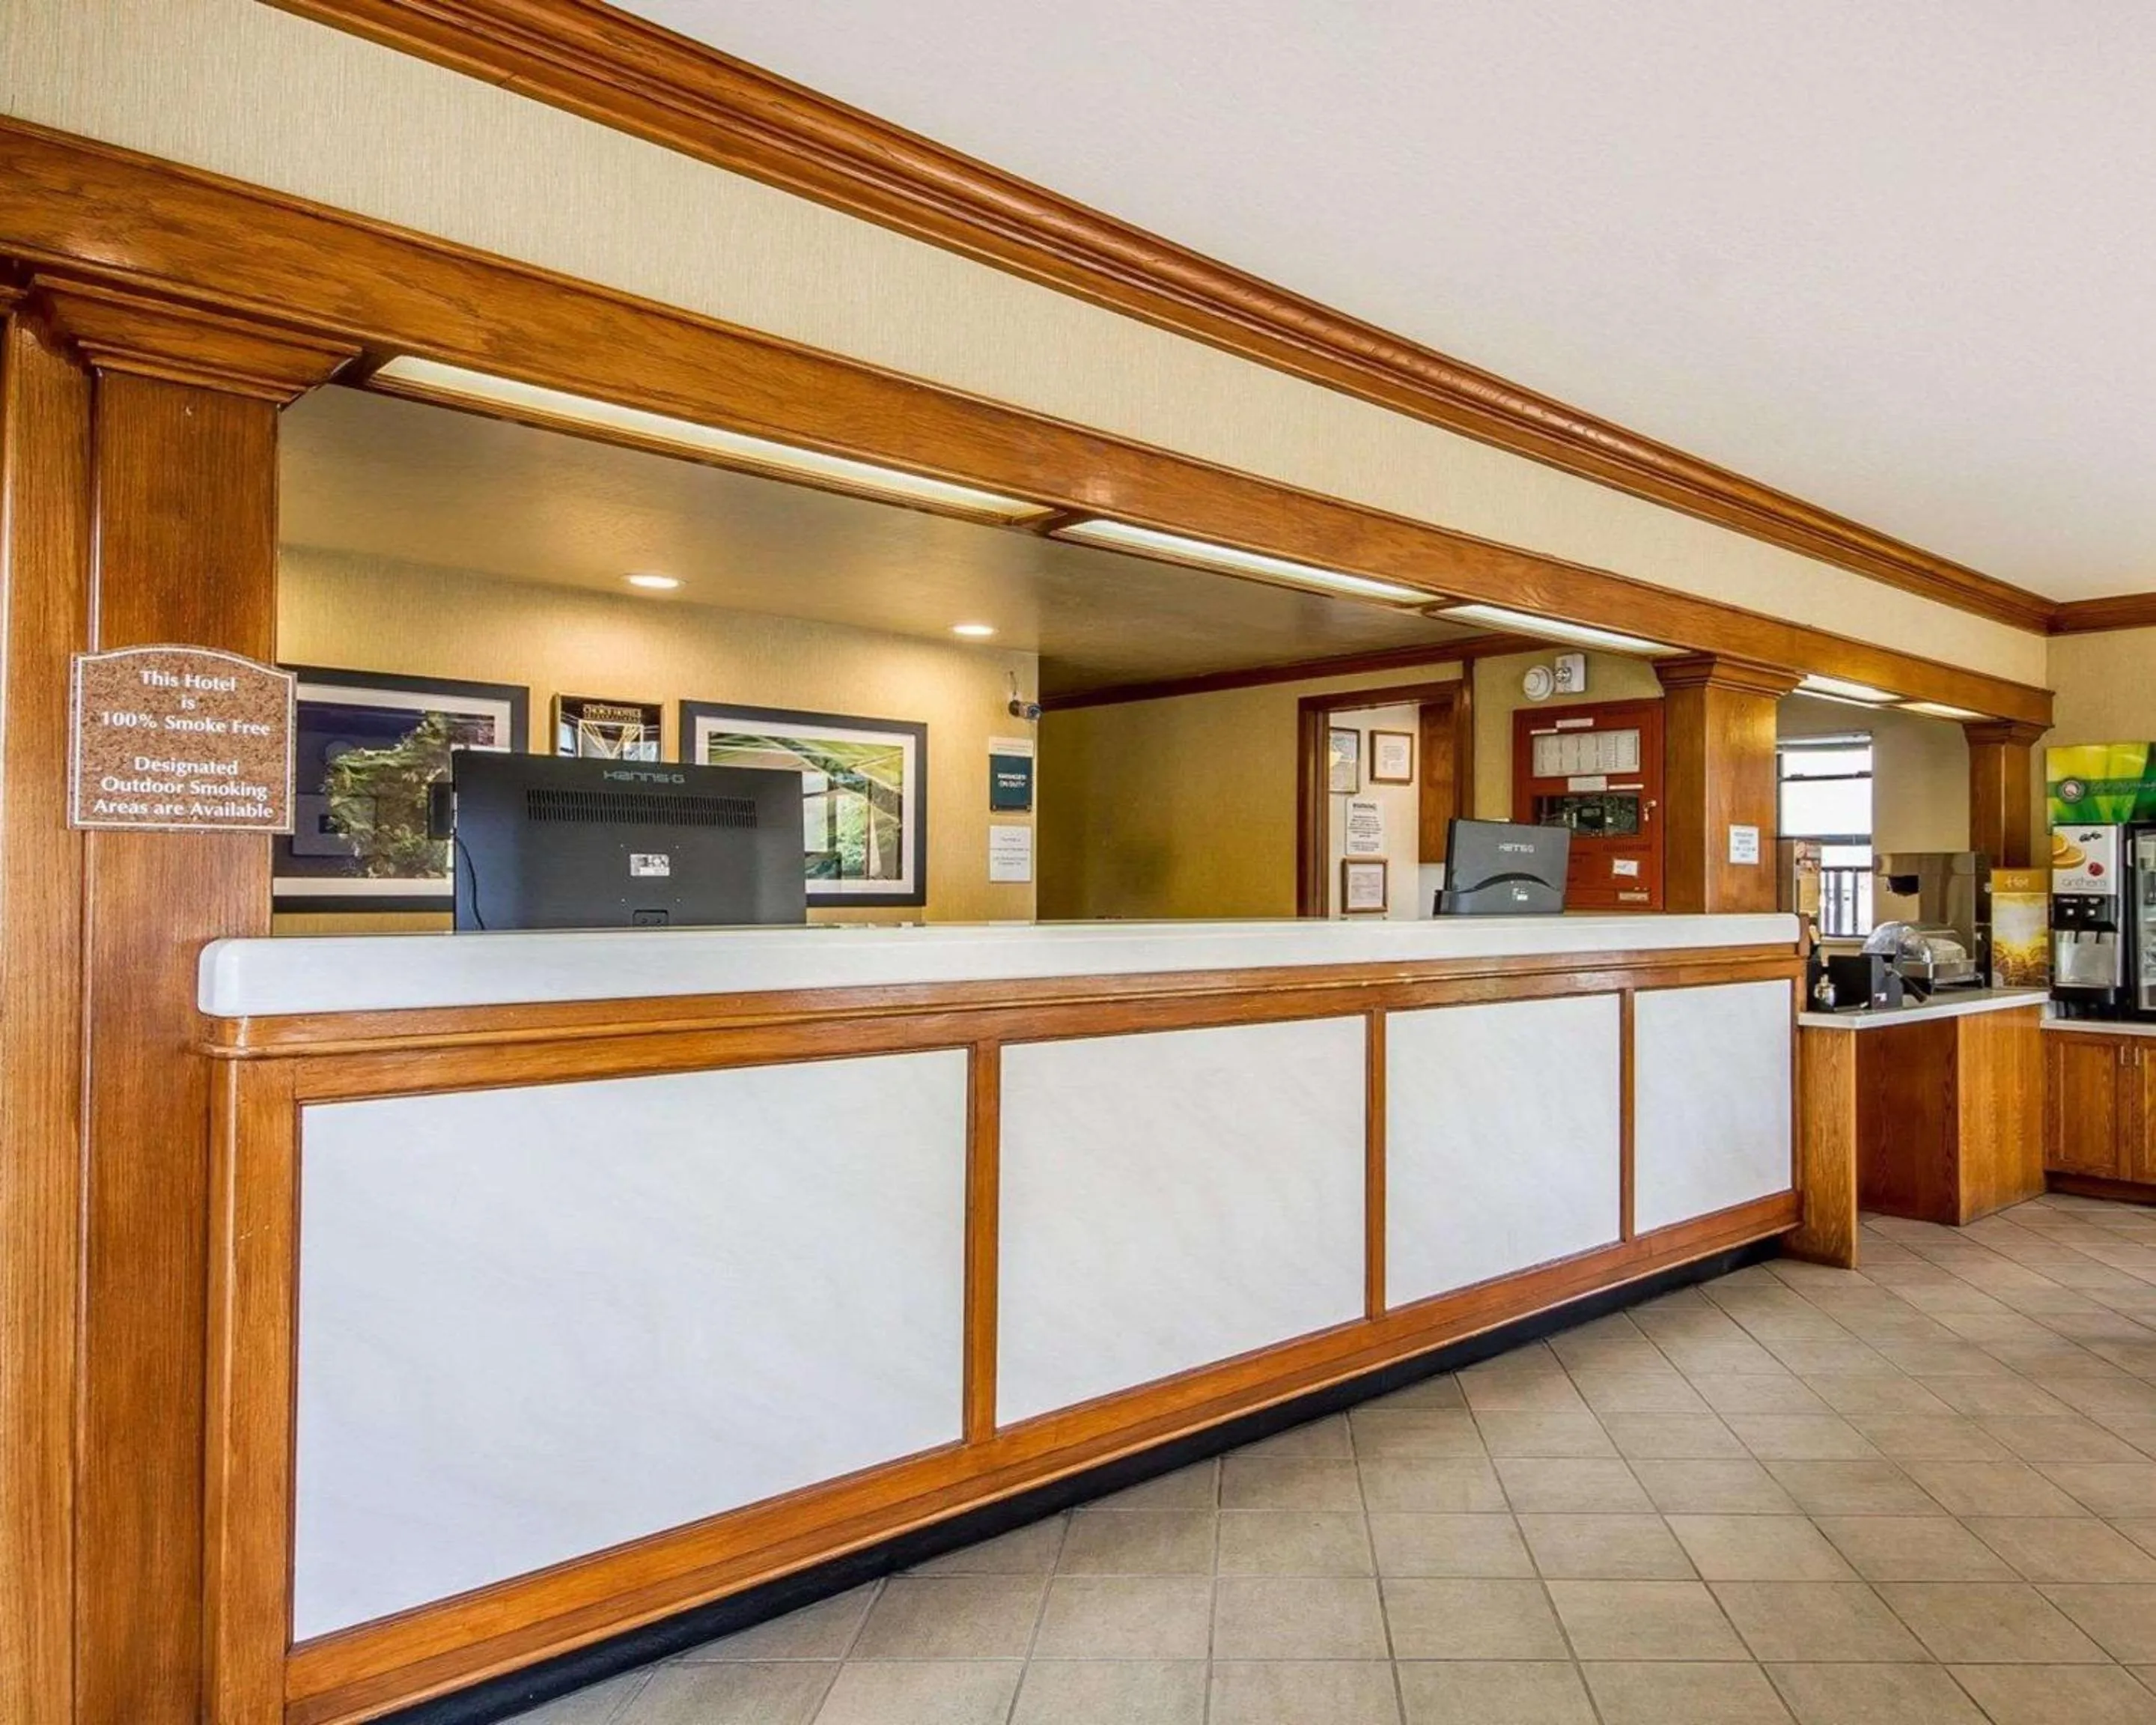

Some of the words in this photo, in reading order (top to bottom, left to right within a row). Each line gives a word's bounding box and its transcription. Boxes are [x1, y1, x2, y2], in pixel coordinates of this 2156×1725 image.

[140, 669, 177, 688] This
[185, 674, 236, 691] Hotel
[180, 695, 196, 710] is
[102, 711, 157, 729] 100%
[165, 715, 226, 734] Smoke
[232, 721, 270, 737] Free
[134, 756, 239, 776] Designated
[100, 776, 184, 794] Outdoor
[189, 780, 268, 802] Smoking
[93, 799, 148, 815] Areas
[153, 803, 184, 815] are
[187, 801, 274, 818] Available
